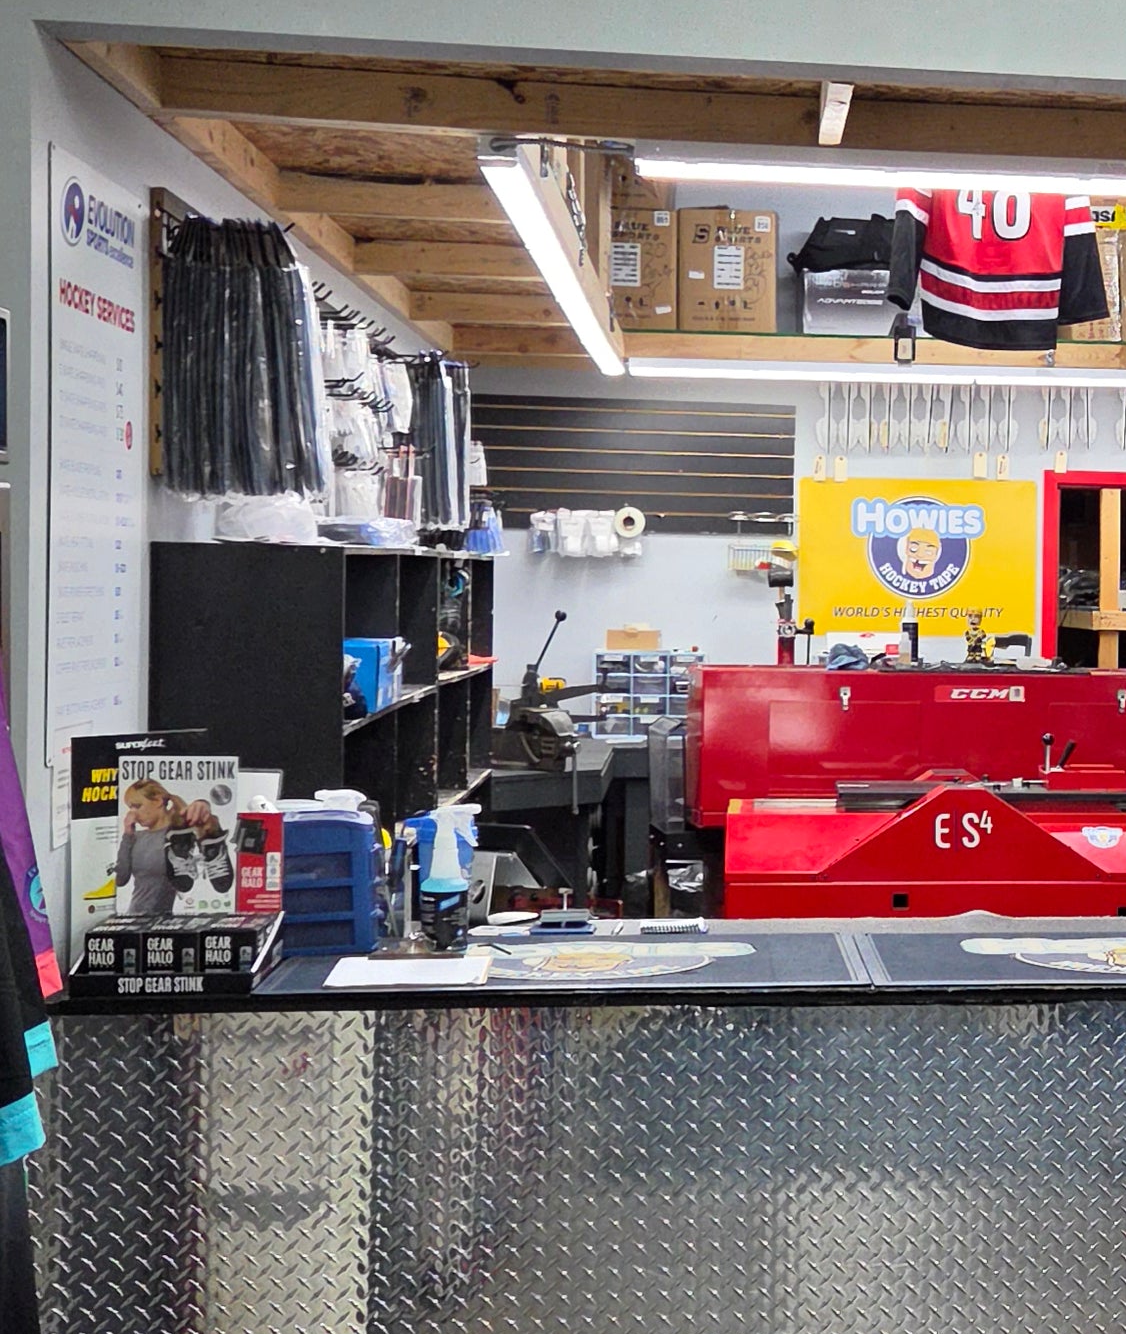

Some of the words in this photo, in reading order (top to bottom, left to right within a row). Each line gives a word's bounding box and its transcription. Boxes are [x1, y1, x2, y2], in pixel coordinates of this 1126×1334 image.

[87, 194, 136, 249] EVOLUTION
[956, 189, 1032, 241] 40
[59, 277, 96, 317] HOCKEY
[97, 295, 136, 334] SERVICES
[854, 500, 984, 536] HOWIES
[879, 562, 928, 594] HOCKEY
[929, 563, 960, 593] TAPE
[833, 606, 891, 618] WORLD'S
[894, 606, 947, 618] HIHEST
[949, 607, 1004, 619] QUITY
[950, 687, 1009, 700] CCM
[91, 767, 119, 784] WHY
[122, 760, 154, 781] STOP
[159, 760, 193, 780] GEAR
[197, 760, 236, 781] STINK
[82, 785, 119, 803] HOCK
[241, 866, 263, 877] GEAR
[241, 877, 263, 888] HALO
[88, 938, 114, 951] GEAR
[146, 937, 173, 950] GEAR
[204, 936, 231, 949] GEAR
[88, 951, 115, 965] HALO
[146, 951, 174, 964] HALO
[204, 949, 232, 963] HALO
[117, 977, 143, 994] STOP
[145, 977, 172, 993] GEAR
[174, 976, 204, 992] STINK
